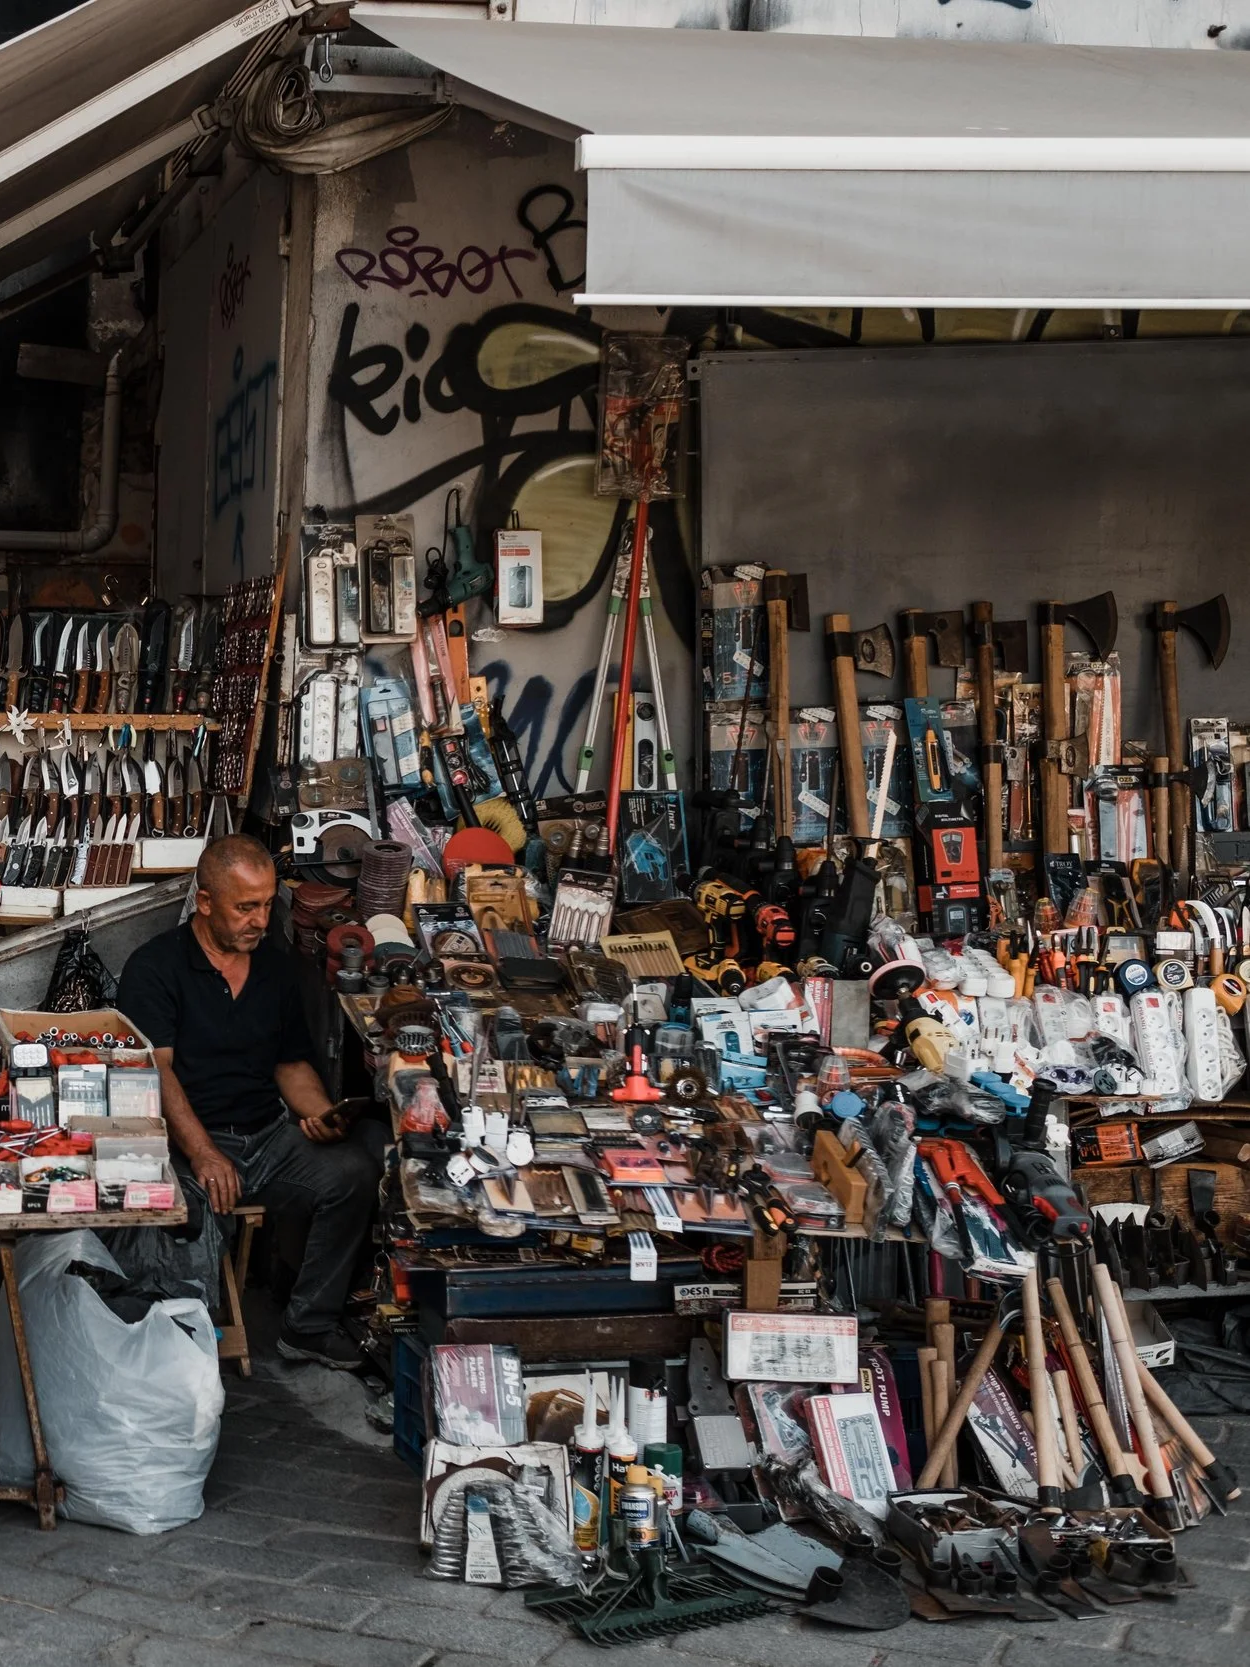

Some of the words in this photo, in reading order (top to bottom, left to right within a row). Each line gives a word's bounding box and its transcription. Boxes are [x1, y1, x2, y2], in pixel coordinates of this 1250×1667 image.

[477, 1356, 486, 1394] ELECTRIC
[501, 1357, 521, 1407] BN-5
[869, 1357, 886, 1389] FOOT
[877, 1385, 891, 1417] PUMP
